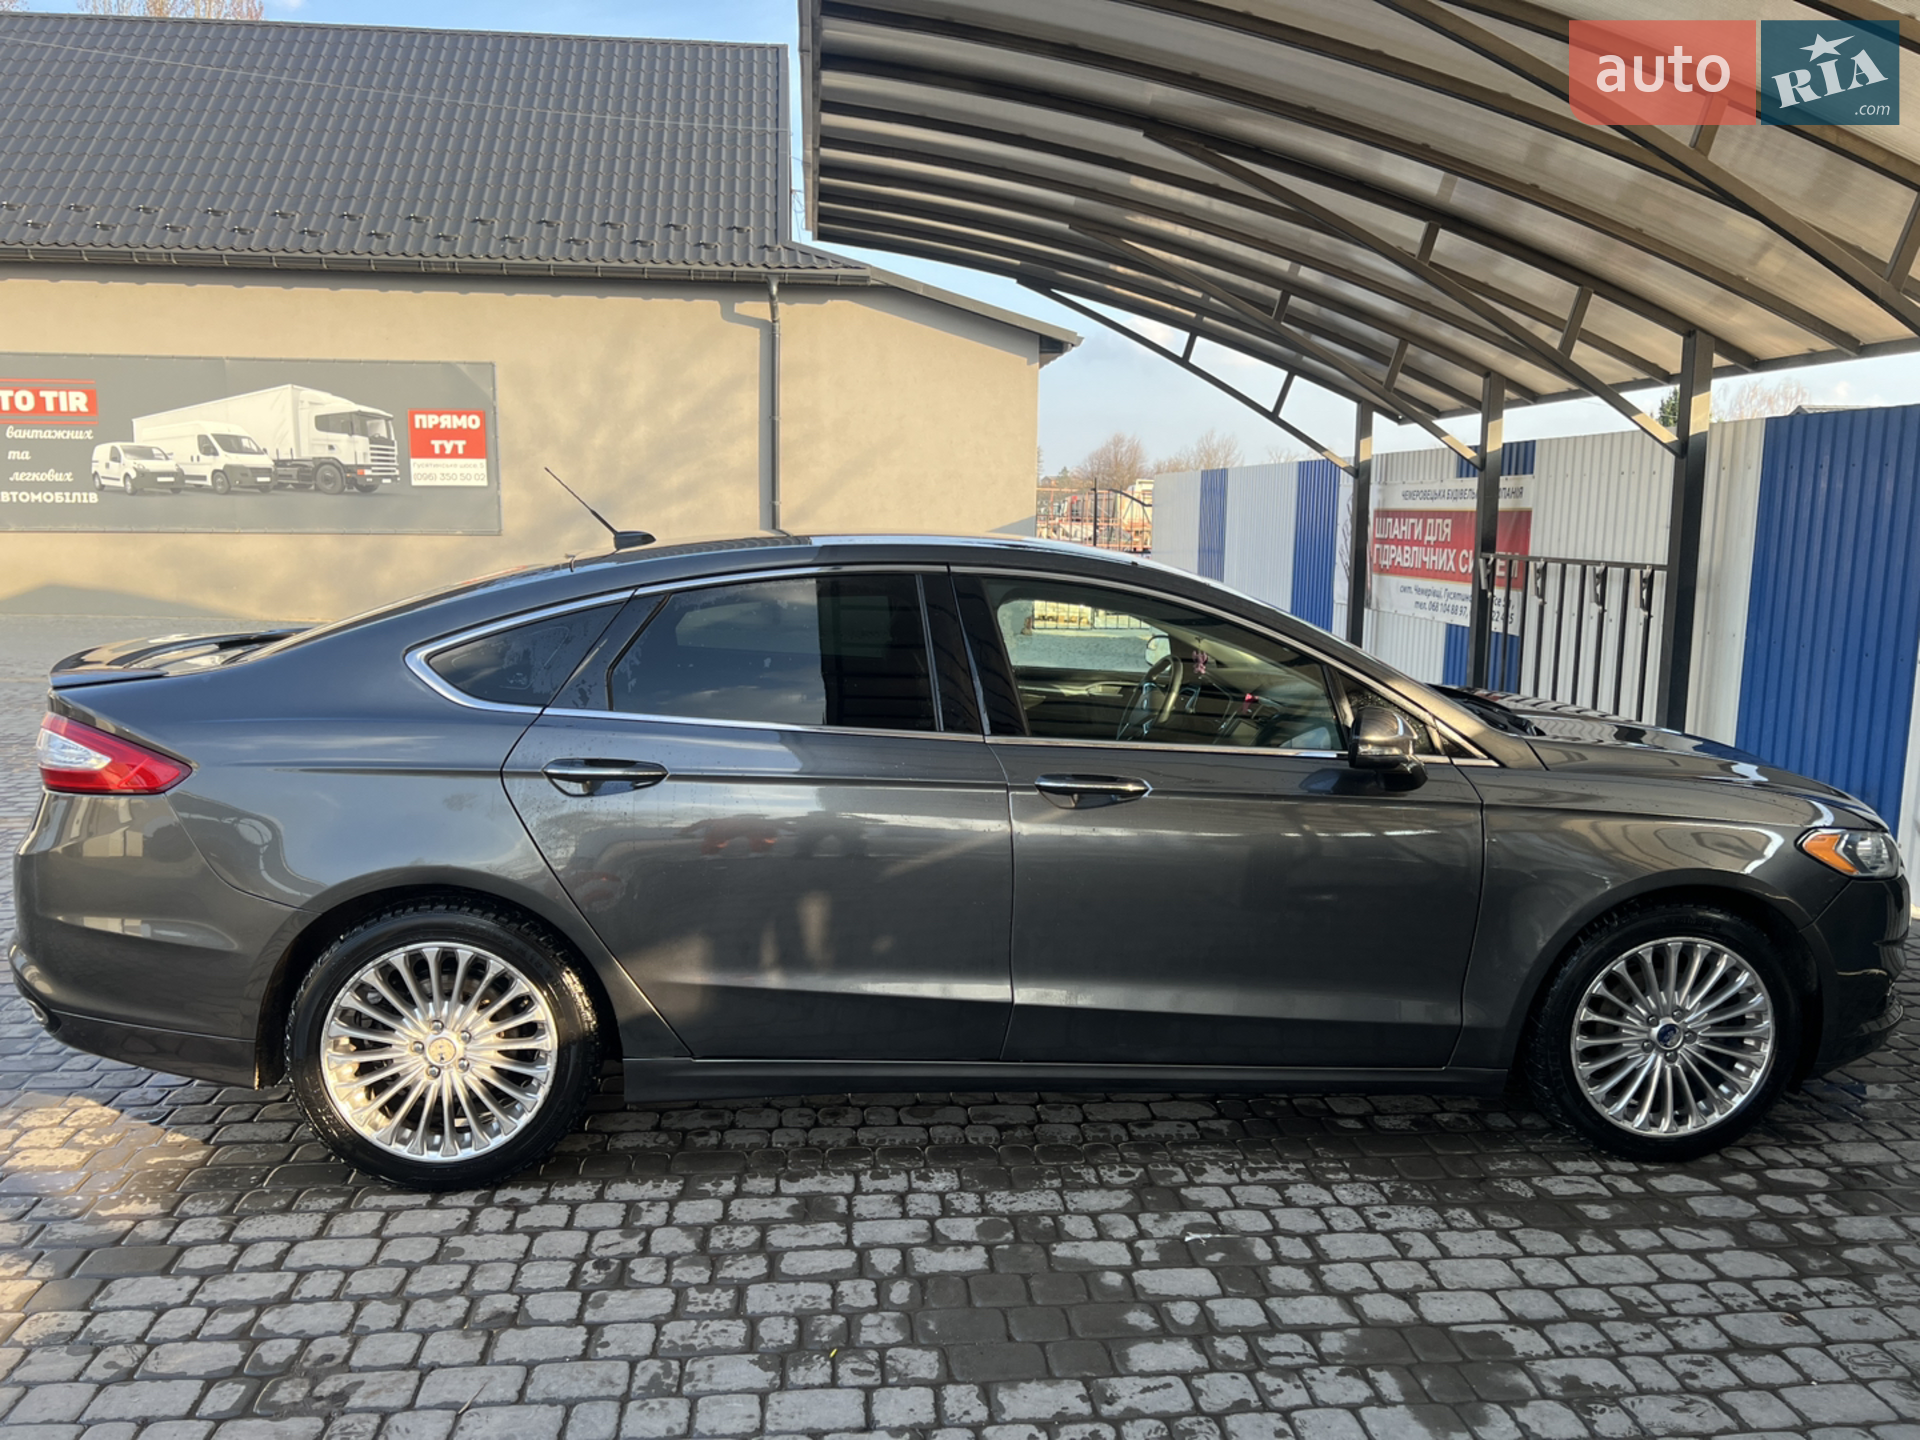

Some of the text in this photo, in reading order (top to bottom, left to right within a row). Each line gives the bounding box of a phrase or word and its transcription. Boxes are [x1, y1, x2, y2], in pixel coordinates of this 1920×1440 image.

[39, 390, 89, 412] TIR
[414, 414, 481, 430] ПРЯМО
[5, 425, 94, 439] вантажних
[430, 440, 467, 454] ТУТ
[7, 450, 31, 460] та
[9, 468, 74, 482] легкових
[459, 473, 472, 481] 50
[474, 473, 486, 481] 02
[1375, 517, 1452, 545] ШЛАНГИ ДЛЯ
